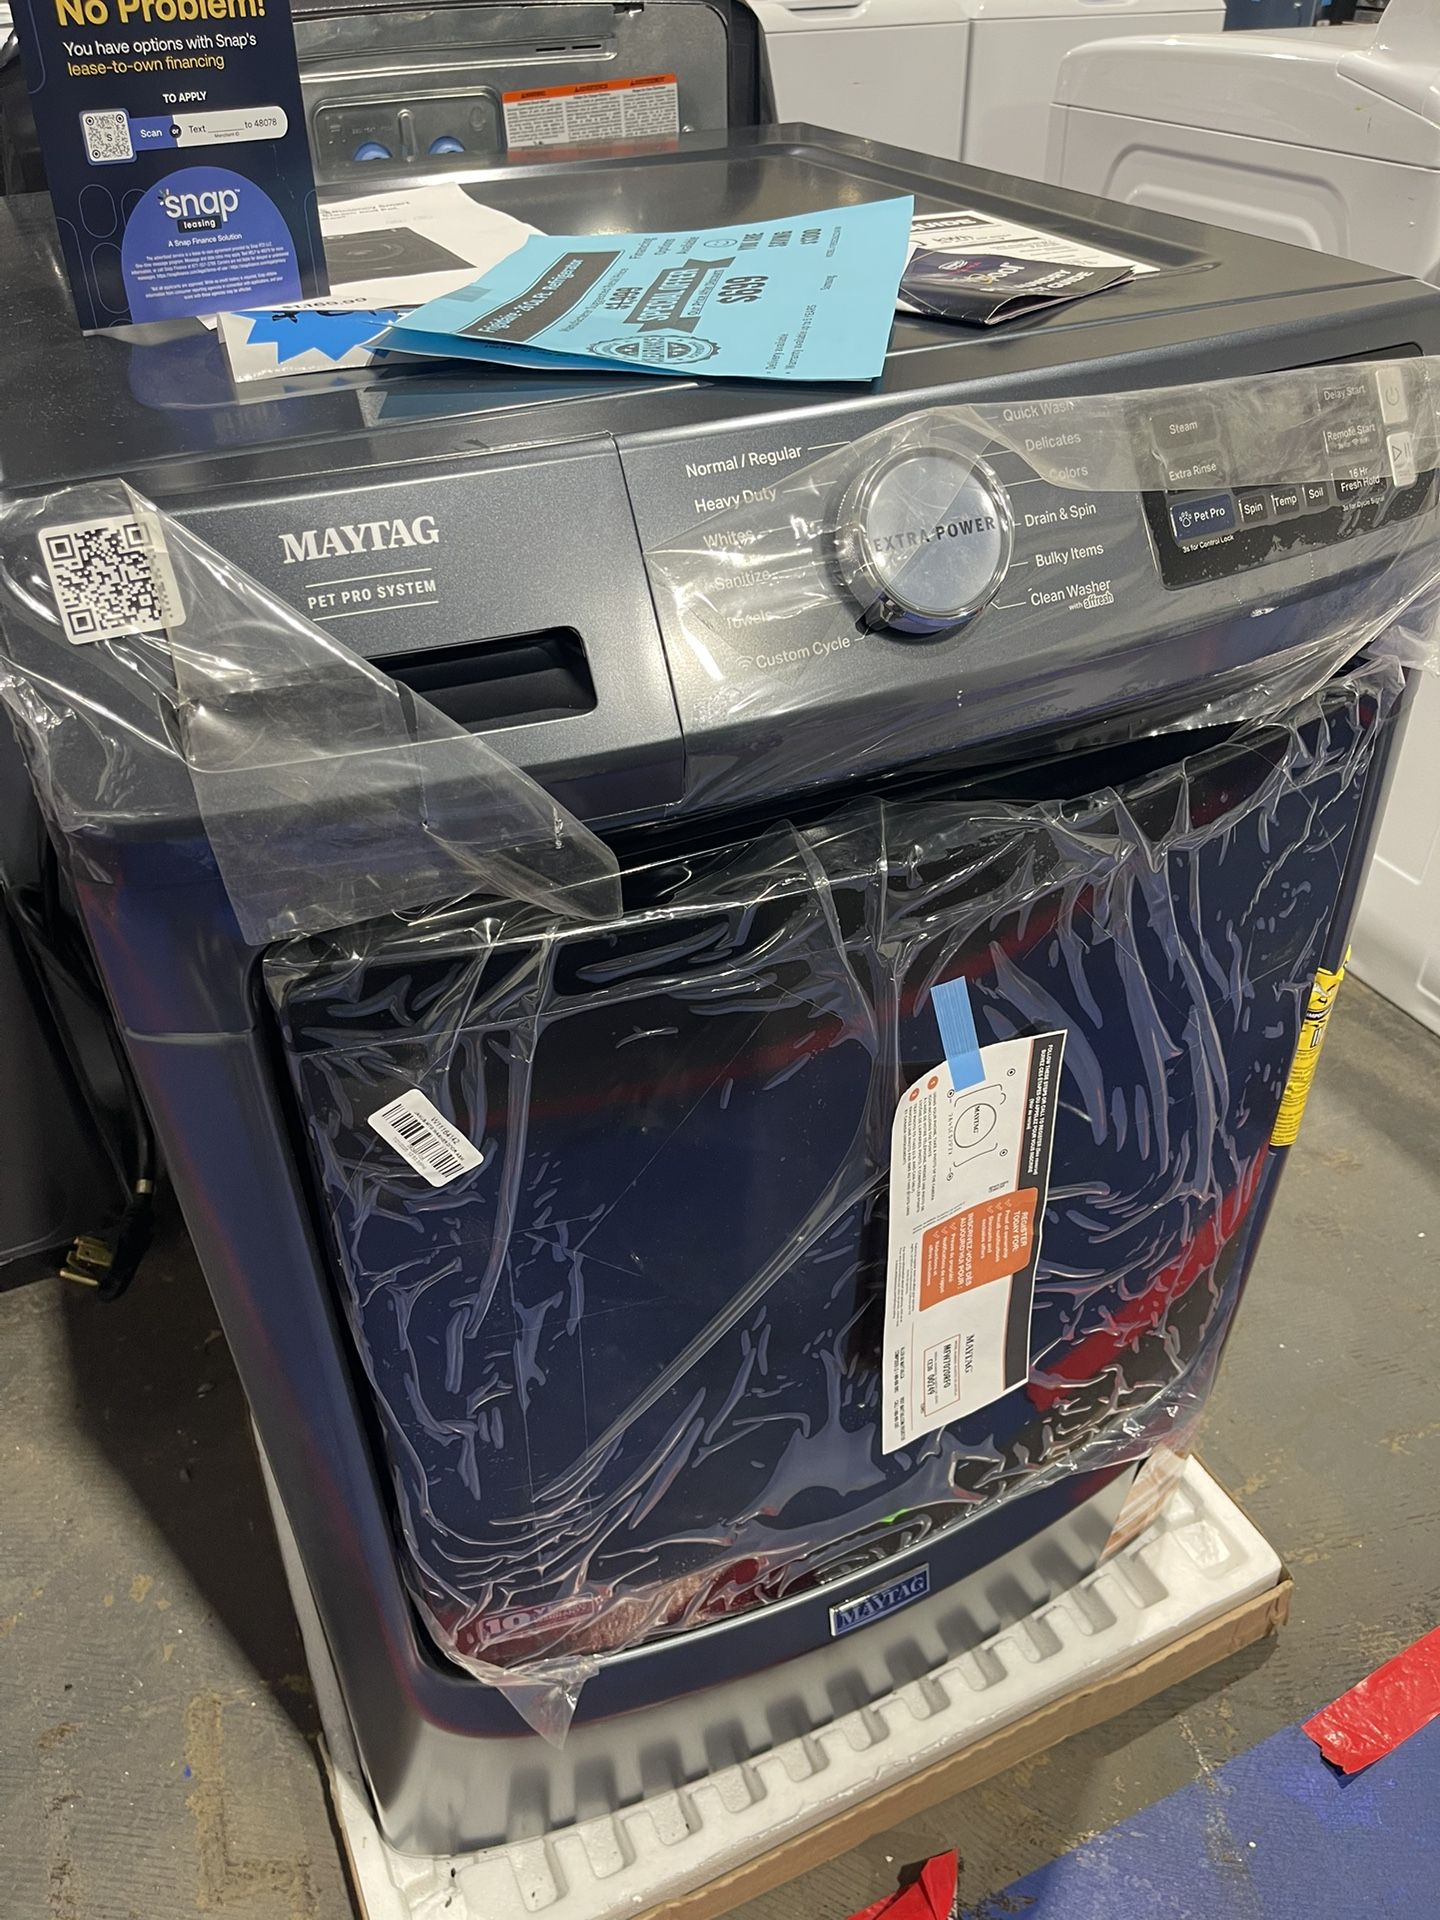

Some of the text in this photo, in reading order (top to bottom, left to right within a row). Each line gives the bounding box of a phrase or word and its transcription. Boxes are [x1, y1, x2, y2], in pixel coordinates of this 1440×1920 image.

[57, 0, 266, 26] No Problem!
[64, 33, 256, 57] You have options with Snap's
[67, 54, 225, 77] lease-to-own financing
[163, 91, 207, 104] TO APPLY
[140, 128, 162, 138] Scan
[189, 125, 206, 134] Text
[254, 118, 277, 128] 48078
[164, 189, 238, 222] snap
[184, 219, 216, 230] leasing
[174, 239, 191, 248] Snap
[192, 237, 216, 245] Finance
[217, 233, 242, 242] Solution
[636, 267, 700, 322] SPECIAL OFFER
[716, 275, 769, 304] $699
[1324, 384, 1366, 401] Delay Start
[1003, 400, 1074, 421] Quick Wash
[1169, 421, 1198, 434] Steam
[1327, 423, 1376, 441] Remote Start
[1025, 434, 1081, 452] Delicates
[685, 446, 802, 478] Normal / Regular
[1169, 462, 1217, 481] Extra Rinse
[1349, 466, 1368, 478] 16 Hr
[1048, 466, 1088, 480] Colors
[1341, 474, 1380, 492] Fresh Hold
[694, 487, 777, 512] Heavy Duty
[1274, 494, 1298, 507] Temp
[1308, 488, 1324, 499] Soil
[1024, 503, 1096, 527] Drain & Spin
[1194, 507, 1226, 522] Pet Pro
[1244, 502, 1263, 515] Spin
[278, 516, 440, 564] MAYTAG
[703, 529, 756, 548] Whites
[873, 516, 996, 552] EXTRA POWER
[1182, 534, 1234, 554] 3s for Control Lock
[1036, 544, 1104, 567] Bulky Items
[714, 570, 771, 590] Sanitize
[308, 580, 436, 610] PET PRO SYSTEM
[1031, 580, 1111, 606] Clean Washer
[1068, 591, 1114, 610] with affresh
[756, 636, 850, 669] Custom Cycle
[965, 1334, 975, 1373] MAYTAG
[840, 1576, 924, 1626] MAYTAG
